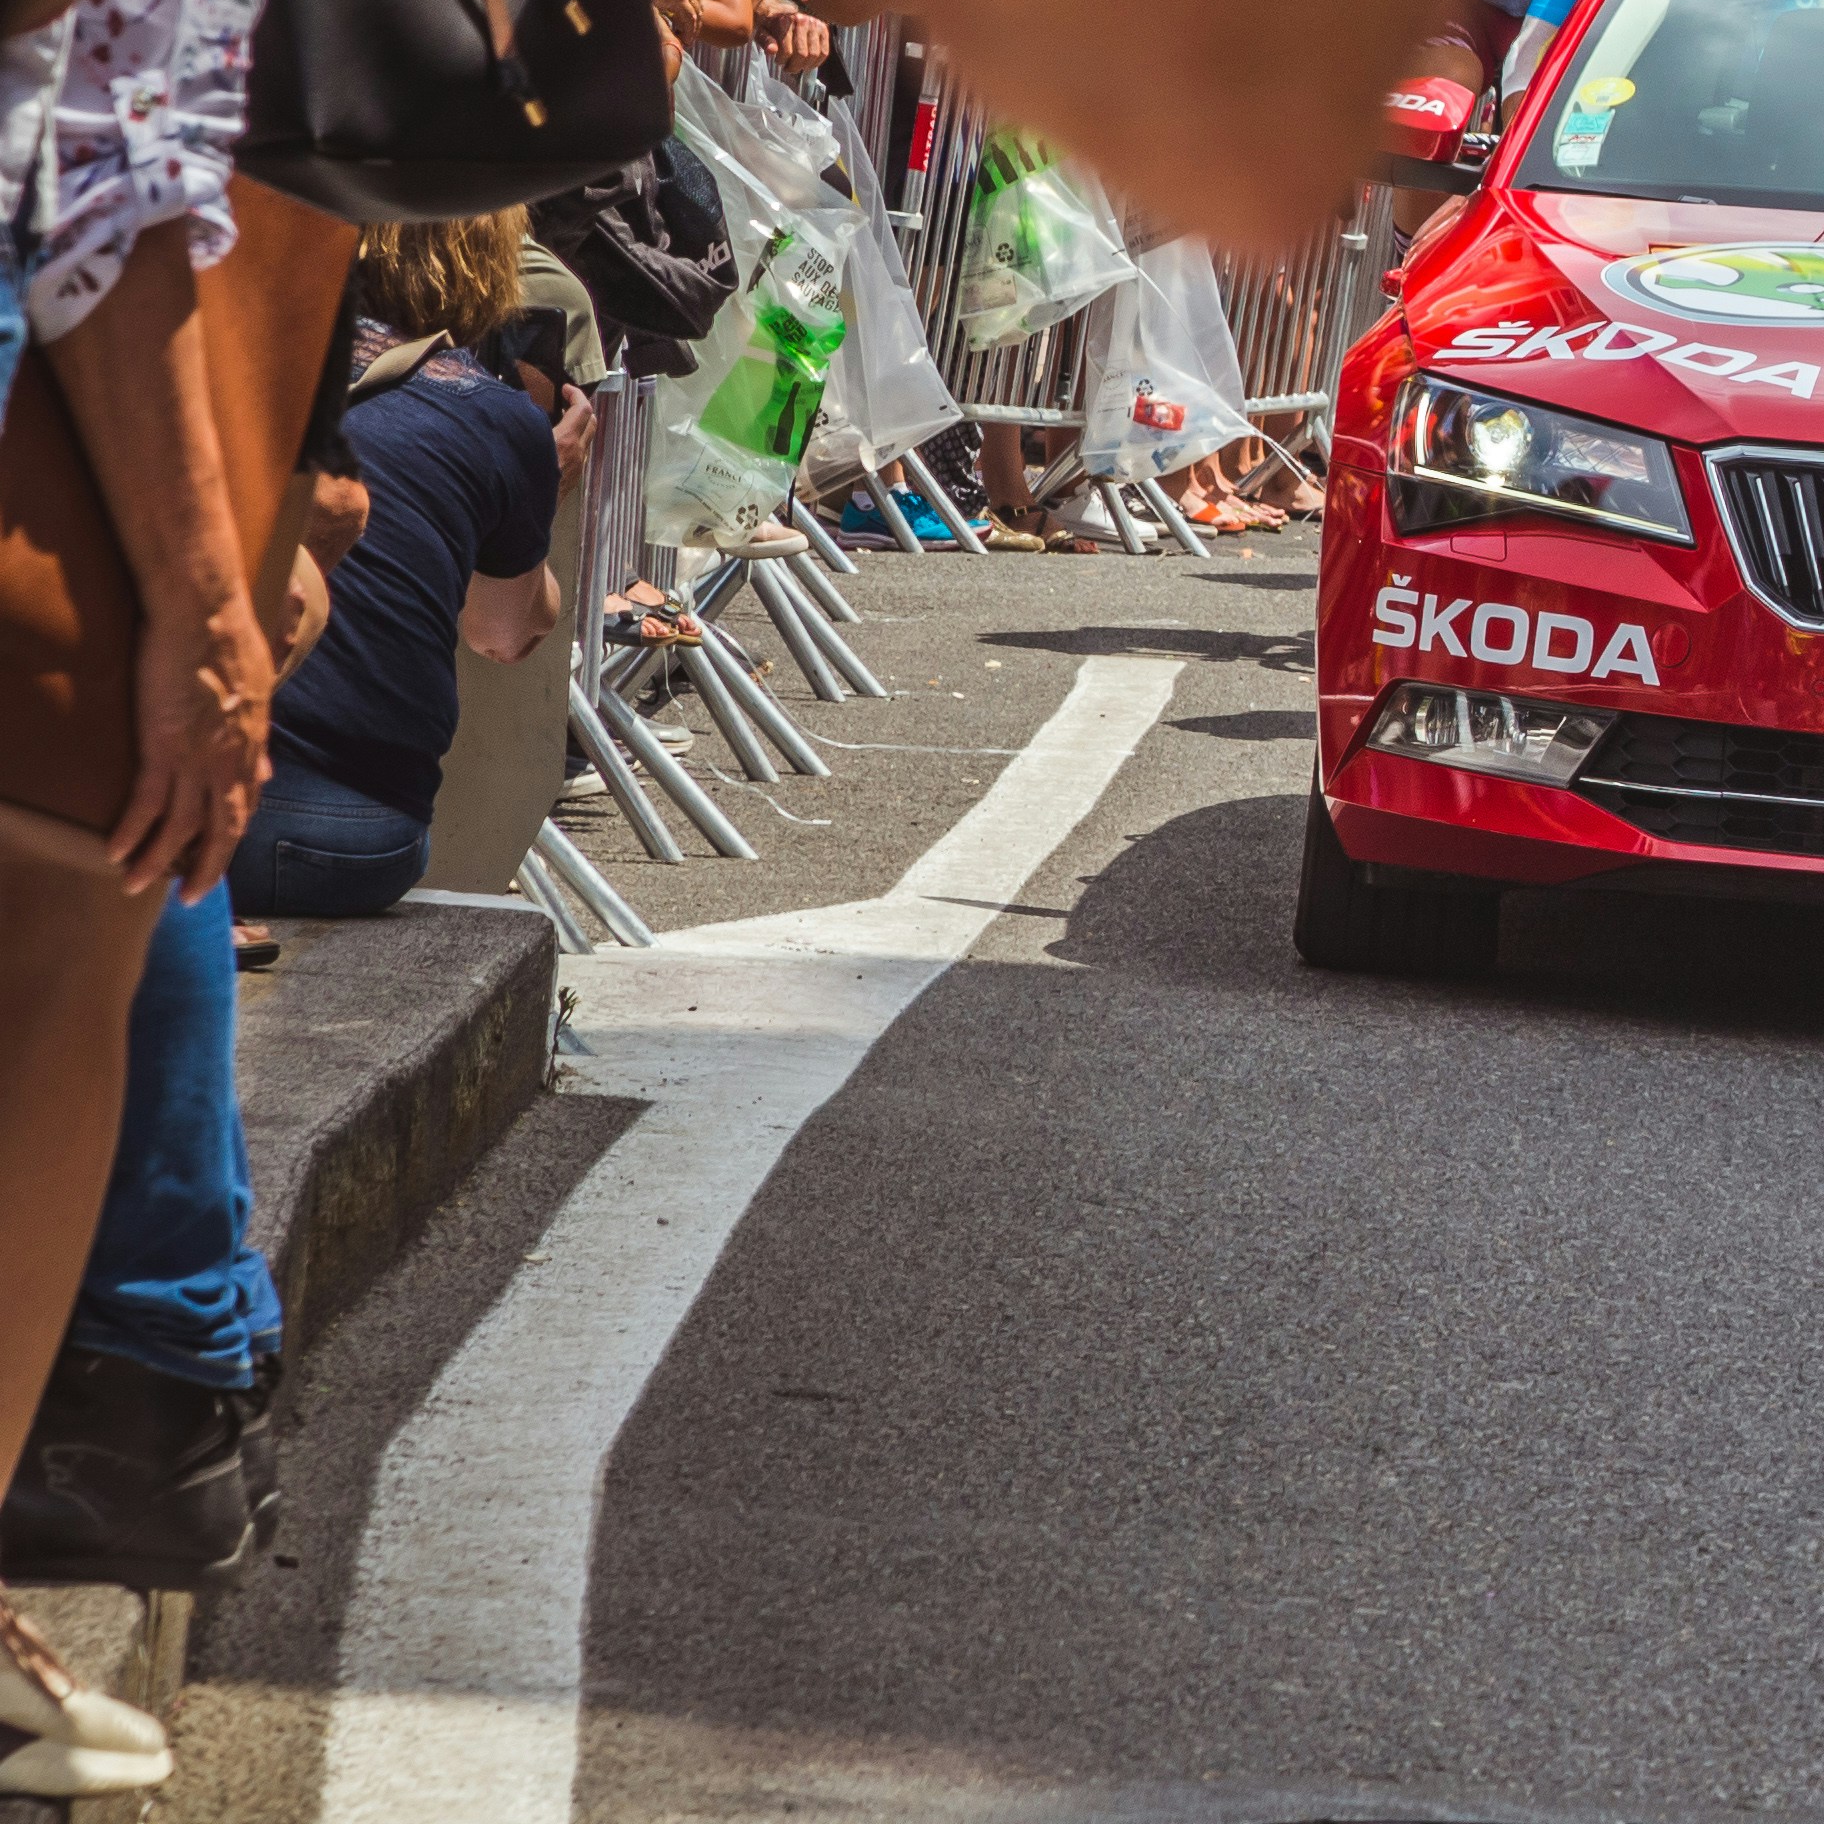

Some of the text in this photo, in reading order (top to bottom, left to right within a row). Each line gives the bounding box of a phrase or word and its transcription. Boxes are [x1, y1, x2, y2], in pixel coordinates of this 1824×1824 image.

[798, 259, 822, 285] AUX
[807, 247, 835, 276] STOP
[1432, 320, 1821, 400] ŠKODA
[1372, 573, 1662, 687] ŠKODA
